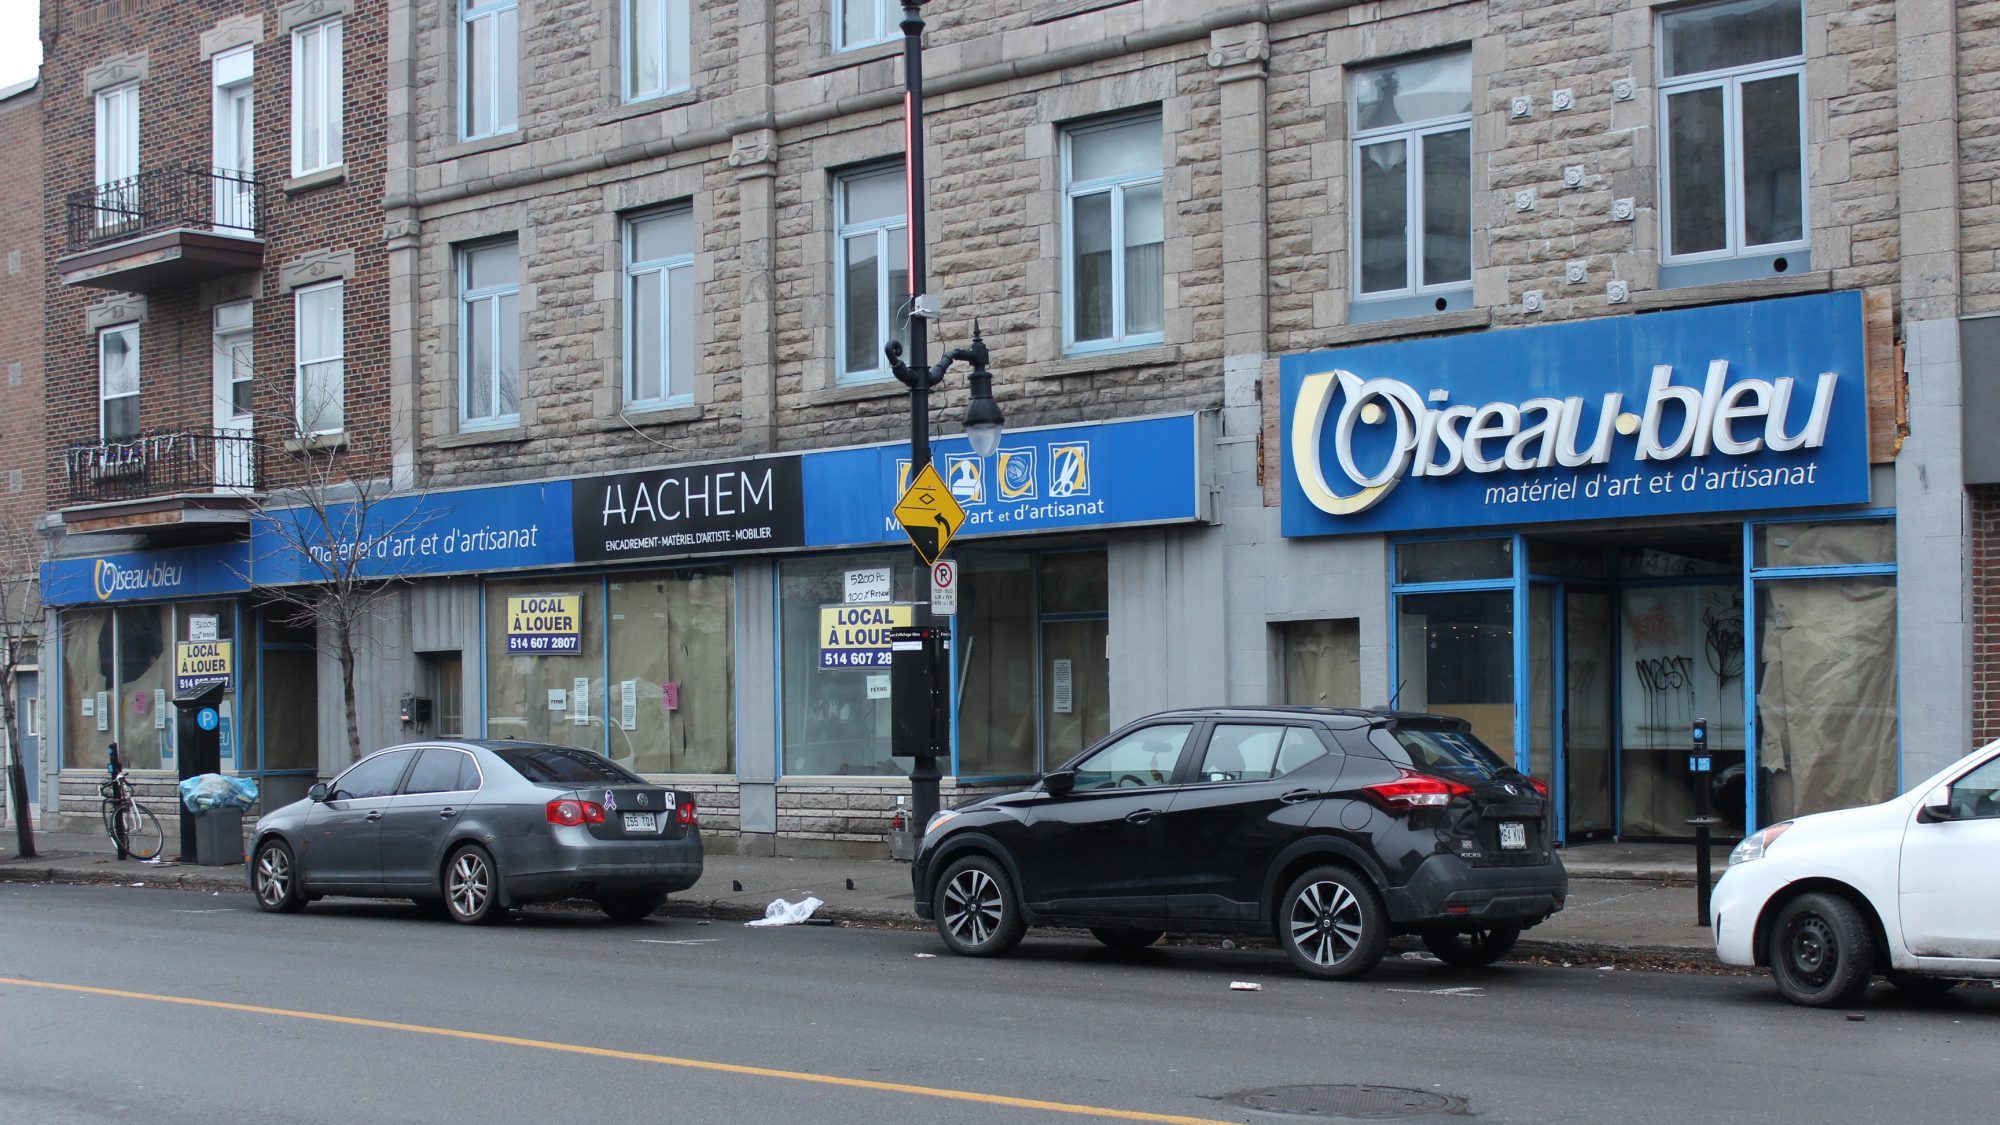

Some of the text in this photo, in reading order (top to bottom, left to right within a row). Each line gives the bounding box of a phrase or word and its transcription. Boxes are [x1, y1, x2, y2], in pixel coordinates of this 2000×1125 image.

[1484, 461, 1818, 505] matériel d'art et d'artisanat
[602, 468, 773, 526] HACHEM
[998, 511, 1010, 522] et
[1014, 499, 1104, 521] d'artisanat
[377, 534, 416, 559] d'art
[421, 532, 438, 556] et
[444, 524, 538, 554] d'artisanat
[661, 533, 695, 547] MATÉRIEL
[696, 530, 731, 544] D'ARTISTE
[735, 527, 772, 541] MOBILIER
[851, 573, 874, 585] 5200
[521, 599, 565, 614] LOCAL
[513, 614, 572, 631] À LOUER
[838, 608, 894, 626] LOCAL
[510, 637, 576, 649] 514 607 2807
[828, 626, 892, 645] À LOUE
[187, 645, 220, 658] LOCAL
[825, 653, 847, 665] 514
[851, 653, 873, 664] 607
[182, 658, 226, 673] À LOUER
[180, 678, 193, 689] 514
[626, 816, 639, 827] Z55
